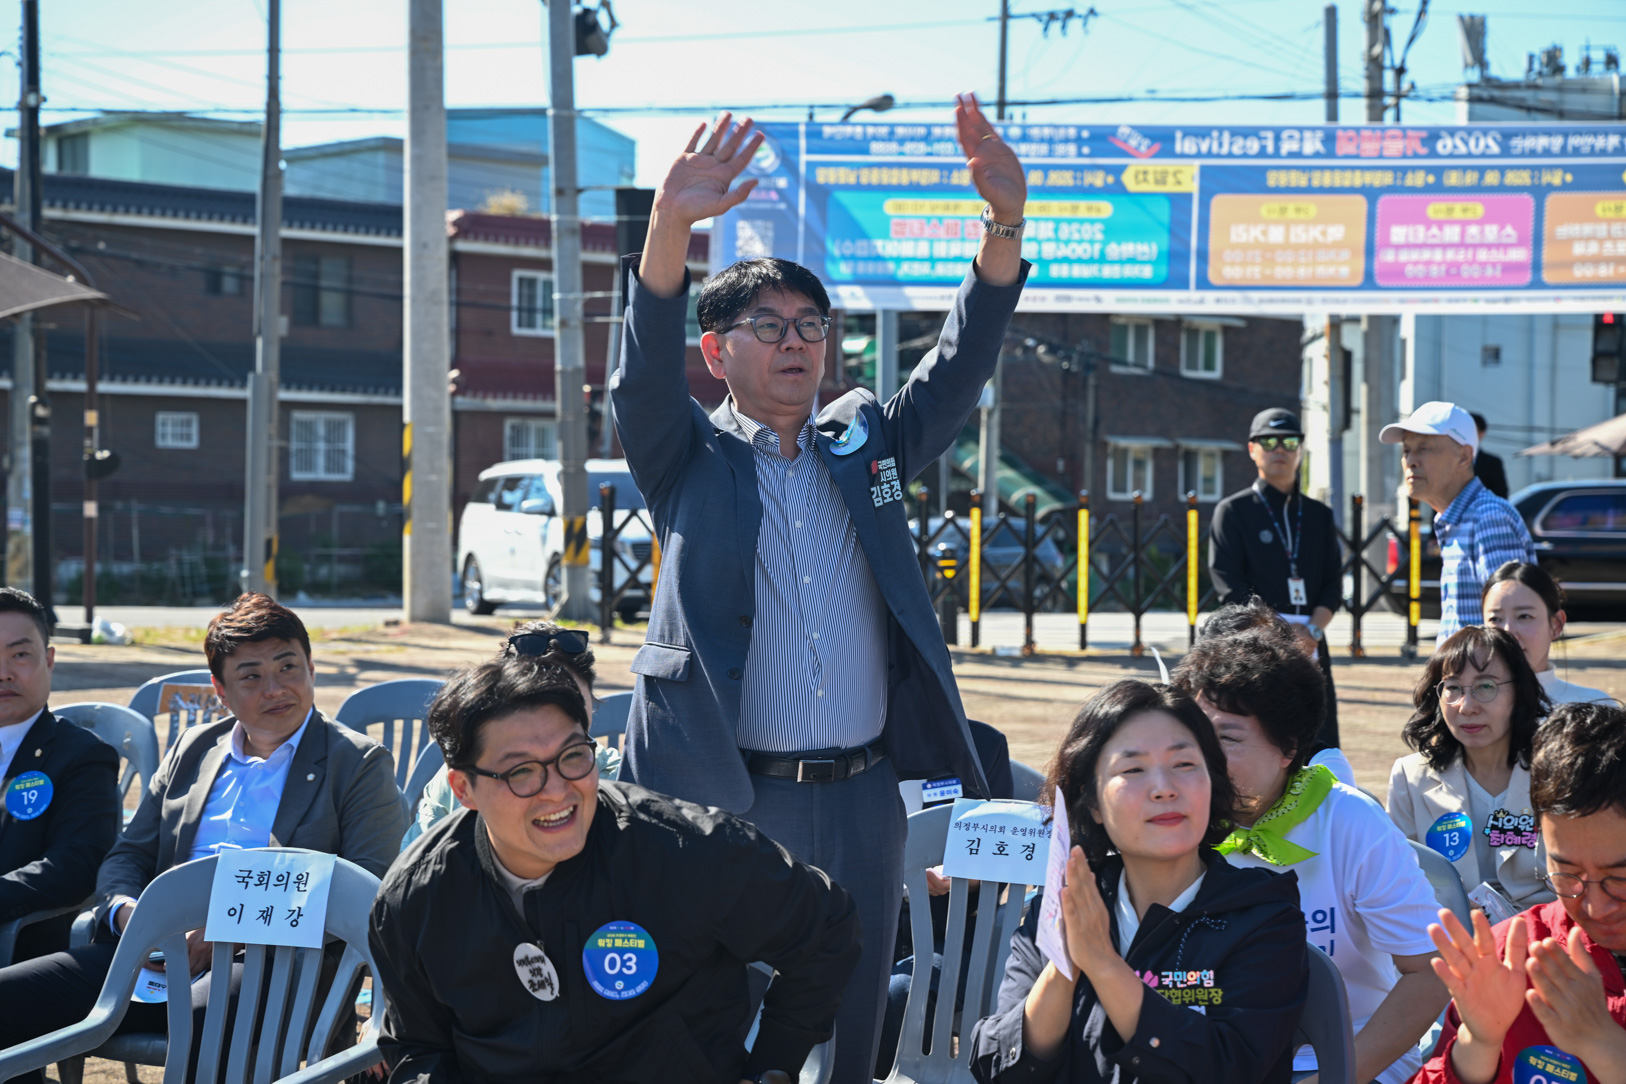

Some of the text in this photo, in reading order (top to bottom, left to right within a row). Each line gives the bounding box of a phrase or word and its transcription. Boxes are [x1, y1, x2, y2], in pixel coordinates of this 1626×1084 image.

[877, 457, 896, 470] 국민의힘
[880, 468, 898, 482] 시의원
[870, 480, 903, 508] 김호경
[21, 790, 38, 805] 19
[954, 821, 1006, 835] 의정부시의회
[1487, 814, 1535, 831] 시의원
[1443, 832, 1459, 847] 13
[1489, 830, 1538, 848] 최혜령
[234, 869, 310, 893] 국회의원
[597, 938, 646, 948] 워킹 페스티벌
[604, 952, 637, 975] 03
[1161, 969, 1214, 988] 국민의힘
